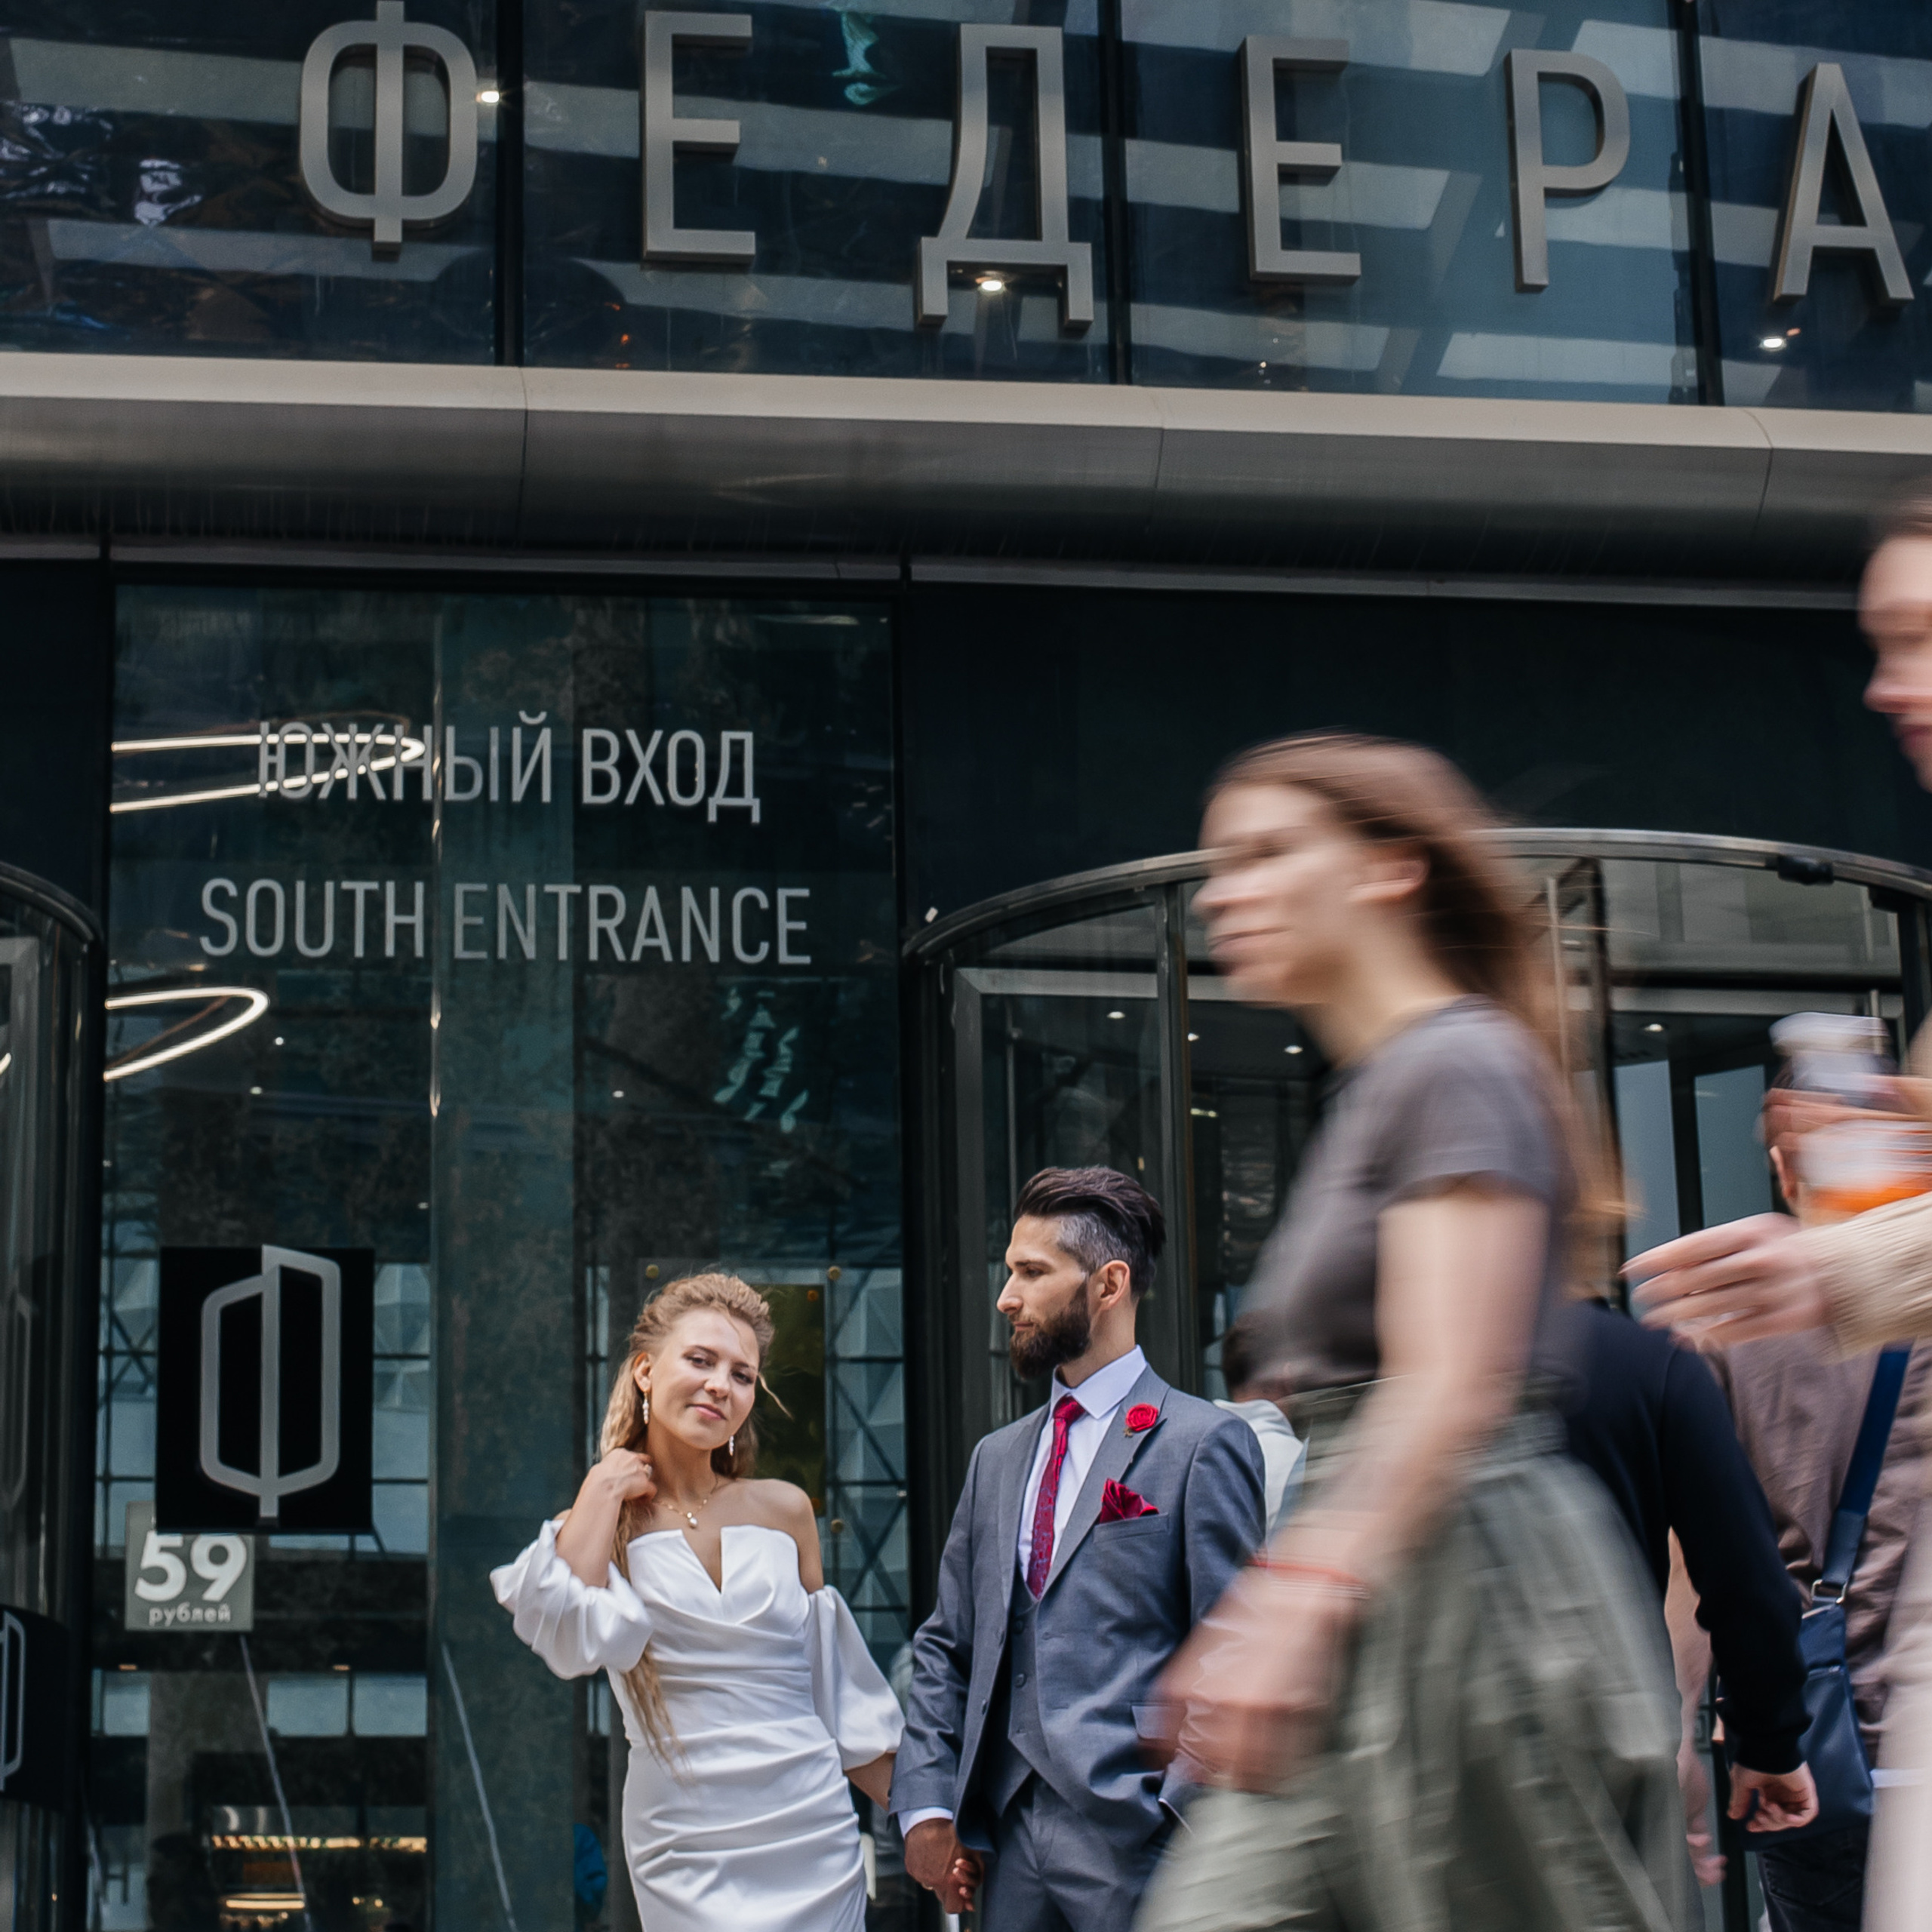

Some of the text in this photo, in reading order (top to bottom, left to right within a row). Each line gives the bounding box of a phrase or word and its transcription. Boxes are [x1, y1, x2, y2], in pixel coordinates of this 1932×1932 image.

[300, 0, 1915, 327] ФЕДЕРА
[257, 710, 761, 823] ЮЖНЫЙ ВХОД
[198, 878, 812, 965] SOUTH ENTRANCE
[134, 1531, 248, 1601] 59
[149, 1602, 231, 1627] рублей
